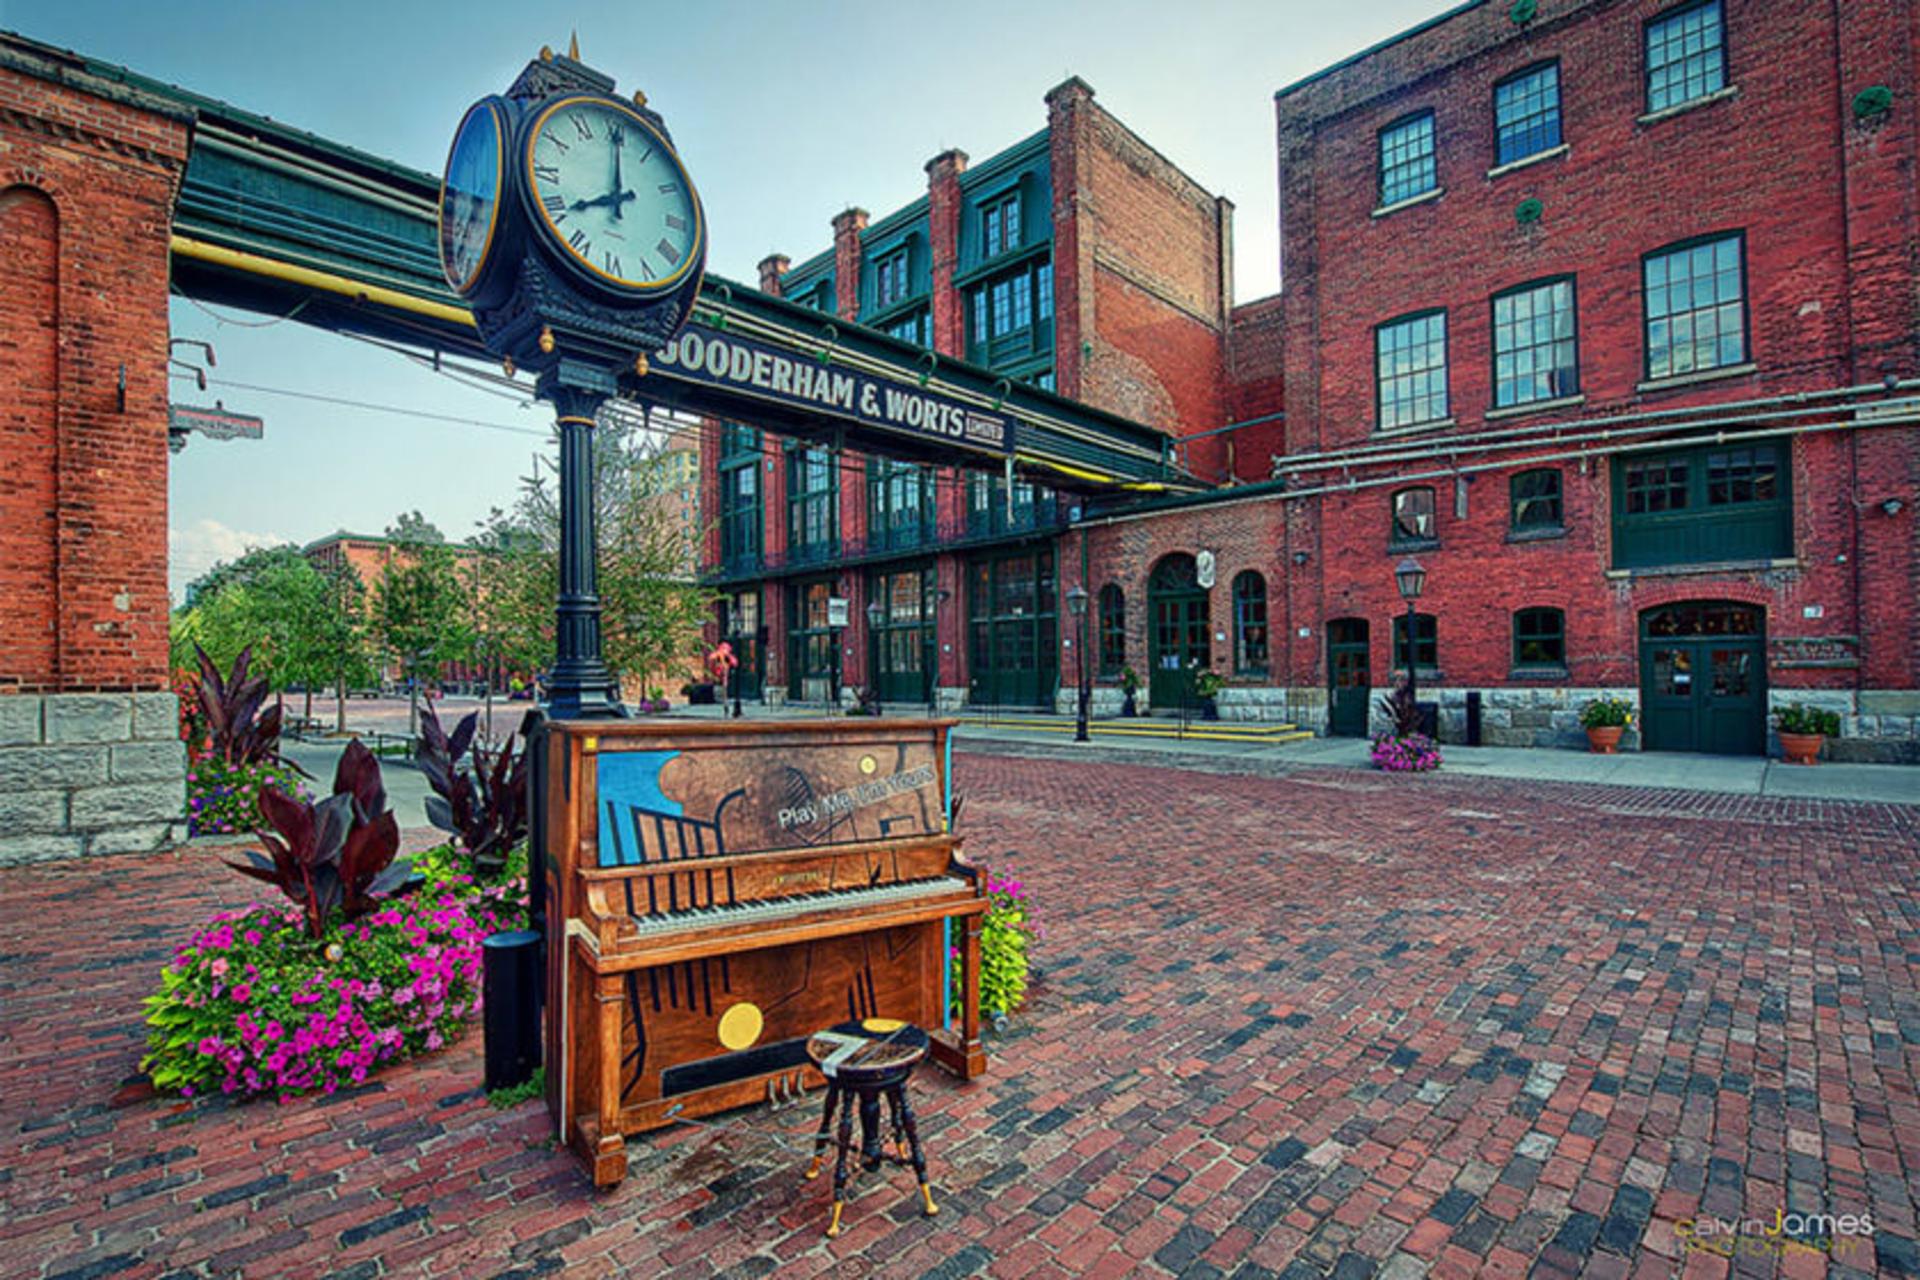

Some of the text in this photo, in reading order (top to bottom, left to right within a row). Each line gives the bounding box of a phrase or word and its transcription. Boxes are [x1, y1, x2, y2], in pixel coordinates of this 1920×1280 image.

[860, 383, 881, 418] &
[885, 389, 964, 437] WORTS
[778, 800, 818, 828] Play
